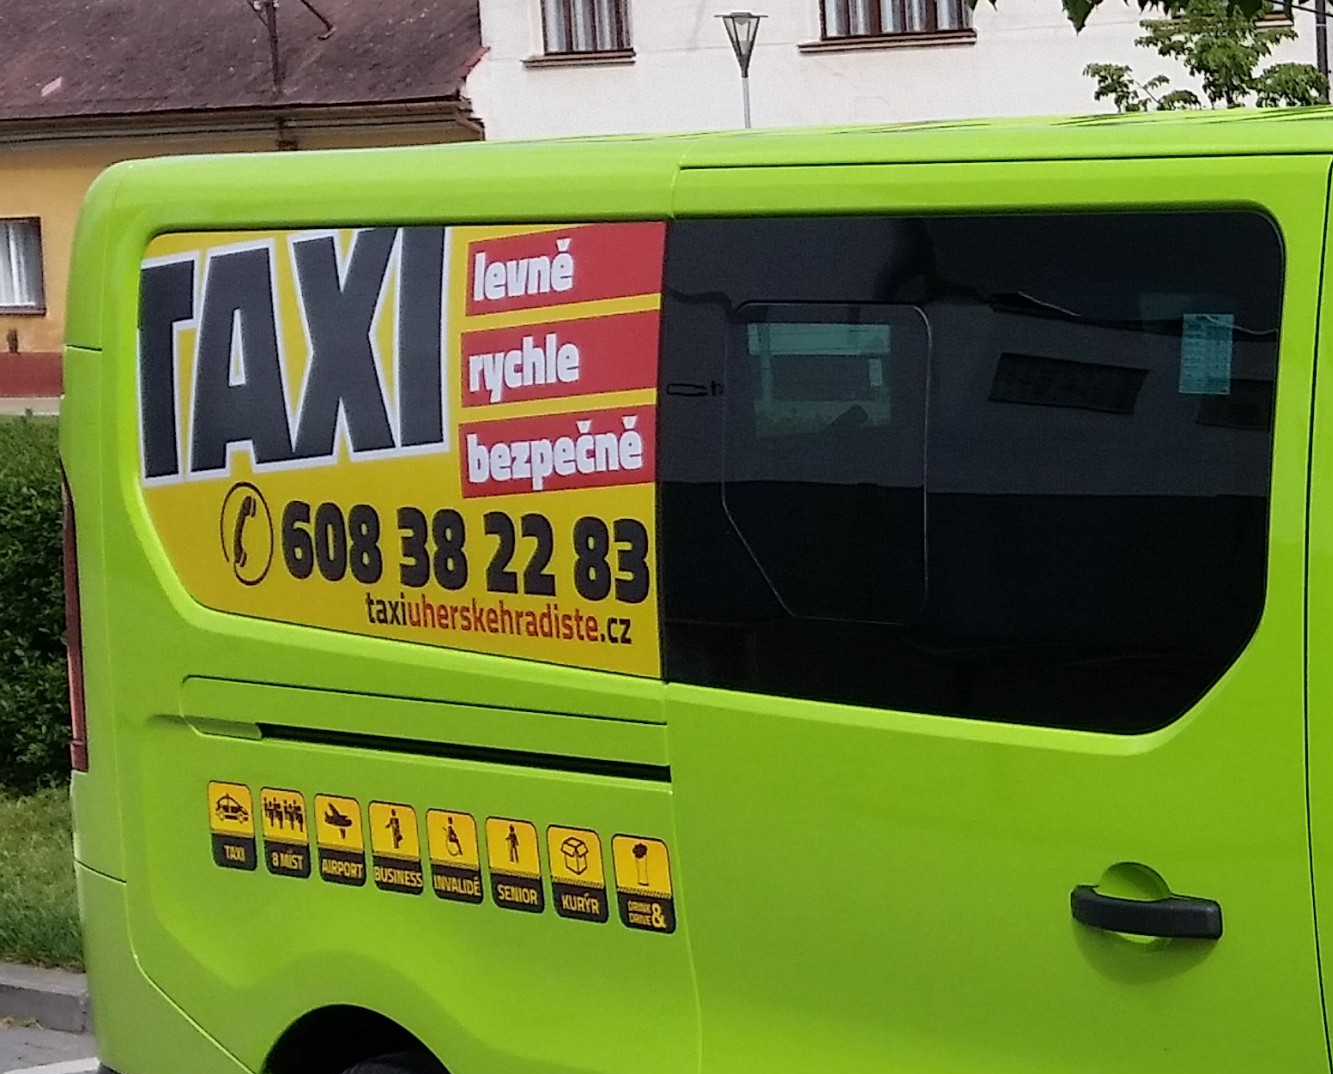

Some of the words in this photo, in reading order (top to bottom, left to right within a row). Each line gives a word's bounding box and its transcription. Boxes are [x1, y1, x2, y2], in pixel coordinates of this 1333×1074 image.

[473, 237, 574, 301] levně
[138, 226, 449, 485] TAXI
[468, 334, 580, 402] rychle
[467, 416, 642, 490] bezpečně
[281, 501, 382, 583] 608
[397, 508, 467, 590] 38
[483, 511, 556, 596] 22
[573, 517, 649, 604] 83
[366, 593, 632, 644] taxiuherskehradiste.cz
[224, 845, 245, 861] TAXI
[272, 854, 279, 867] 8
[322, 859, 363, 878] AIRPORT
[375, 867, 422, 887] BUSINESS
[434, 876, 480, 896] INVALIDÉ
[497, 884, 538, 904] SENIOR
[562, 893, 599, 914] KURÝR
